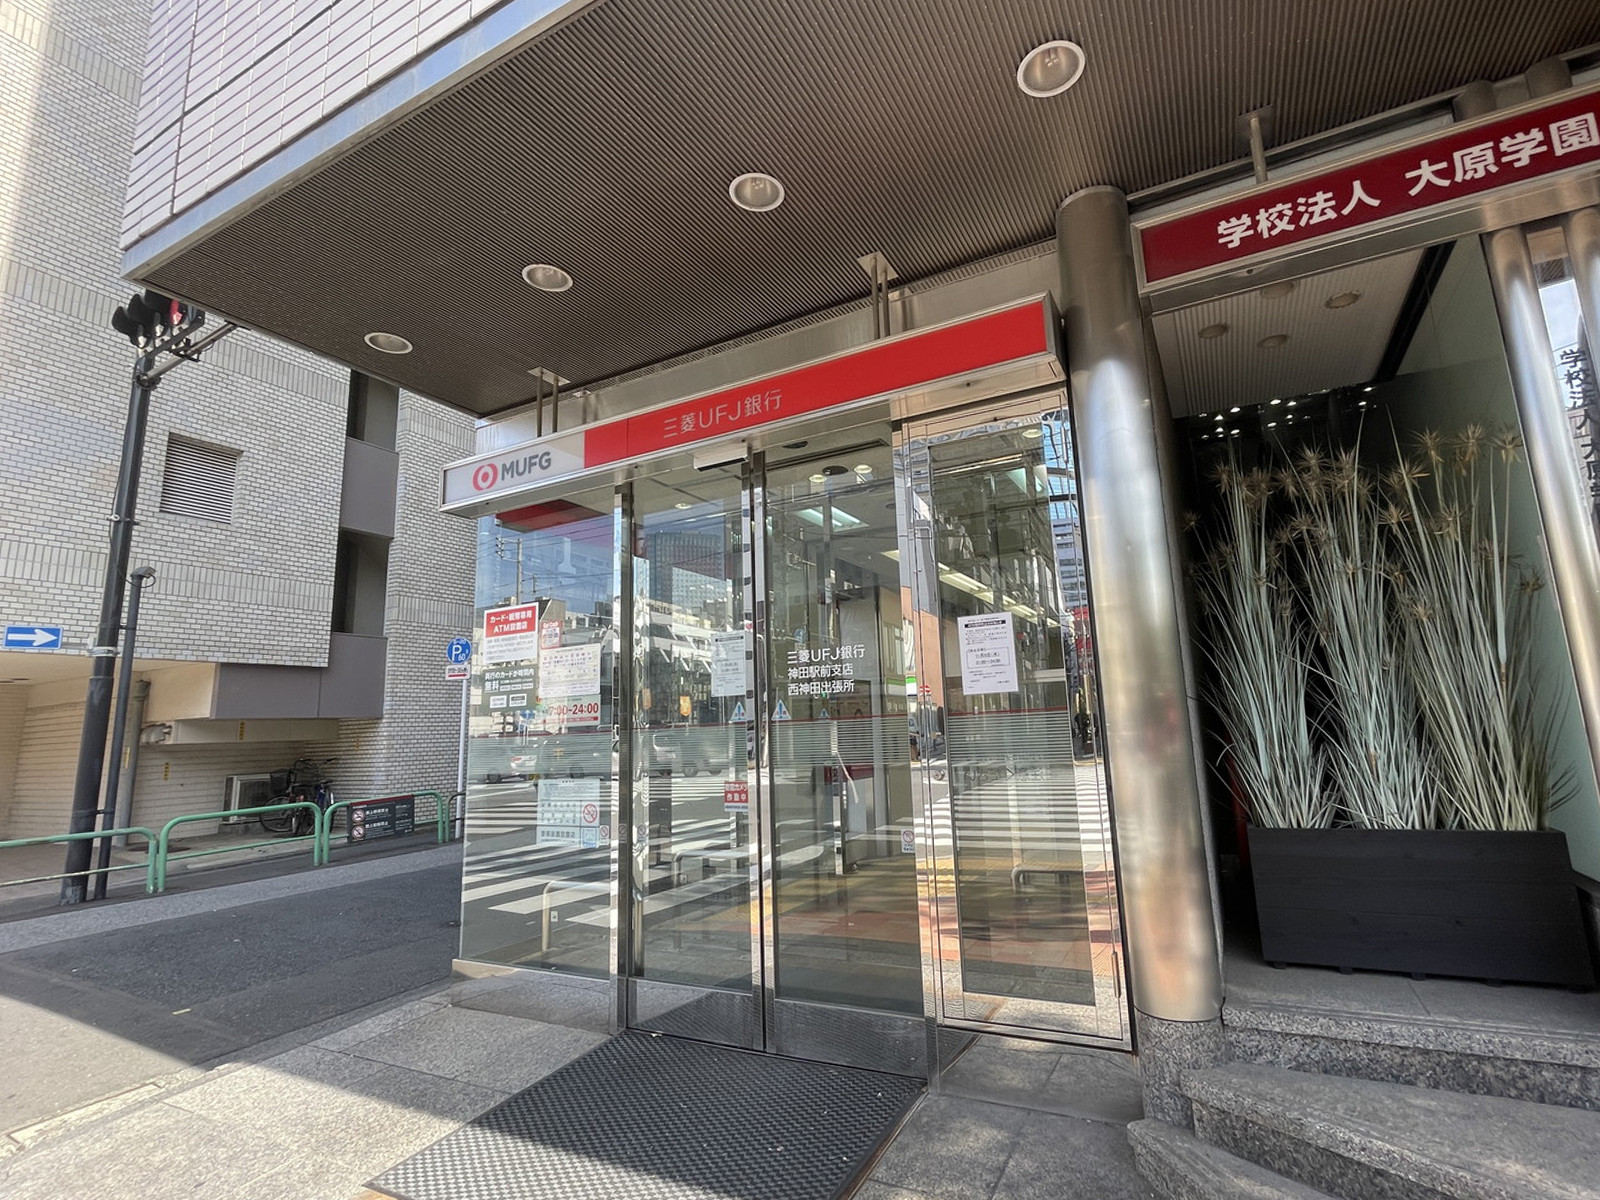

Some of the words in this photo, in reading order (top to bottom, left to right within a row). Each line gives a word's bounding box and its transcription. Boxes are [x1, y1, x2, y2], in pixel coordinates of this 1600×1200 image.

[1217, 180, 1381, 249] 学校法人
[1405, 112, 1599, 197] 大原学園
[663, 389, 783, 438] 三菱UFJ銀行
[501, 452, 552, 481] MUFG
[452, 644, 462, 661] P
[787, 645, 865, 665] 三菱UFJ銀行
[787, 663, 853, 680] 神田駅前支店
[788, 680, 855, 696] 西神田出張所
